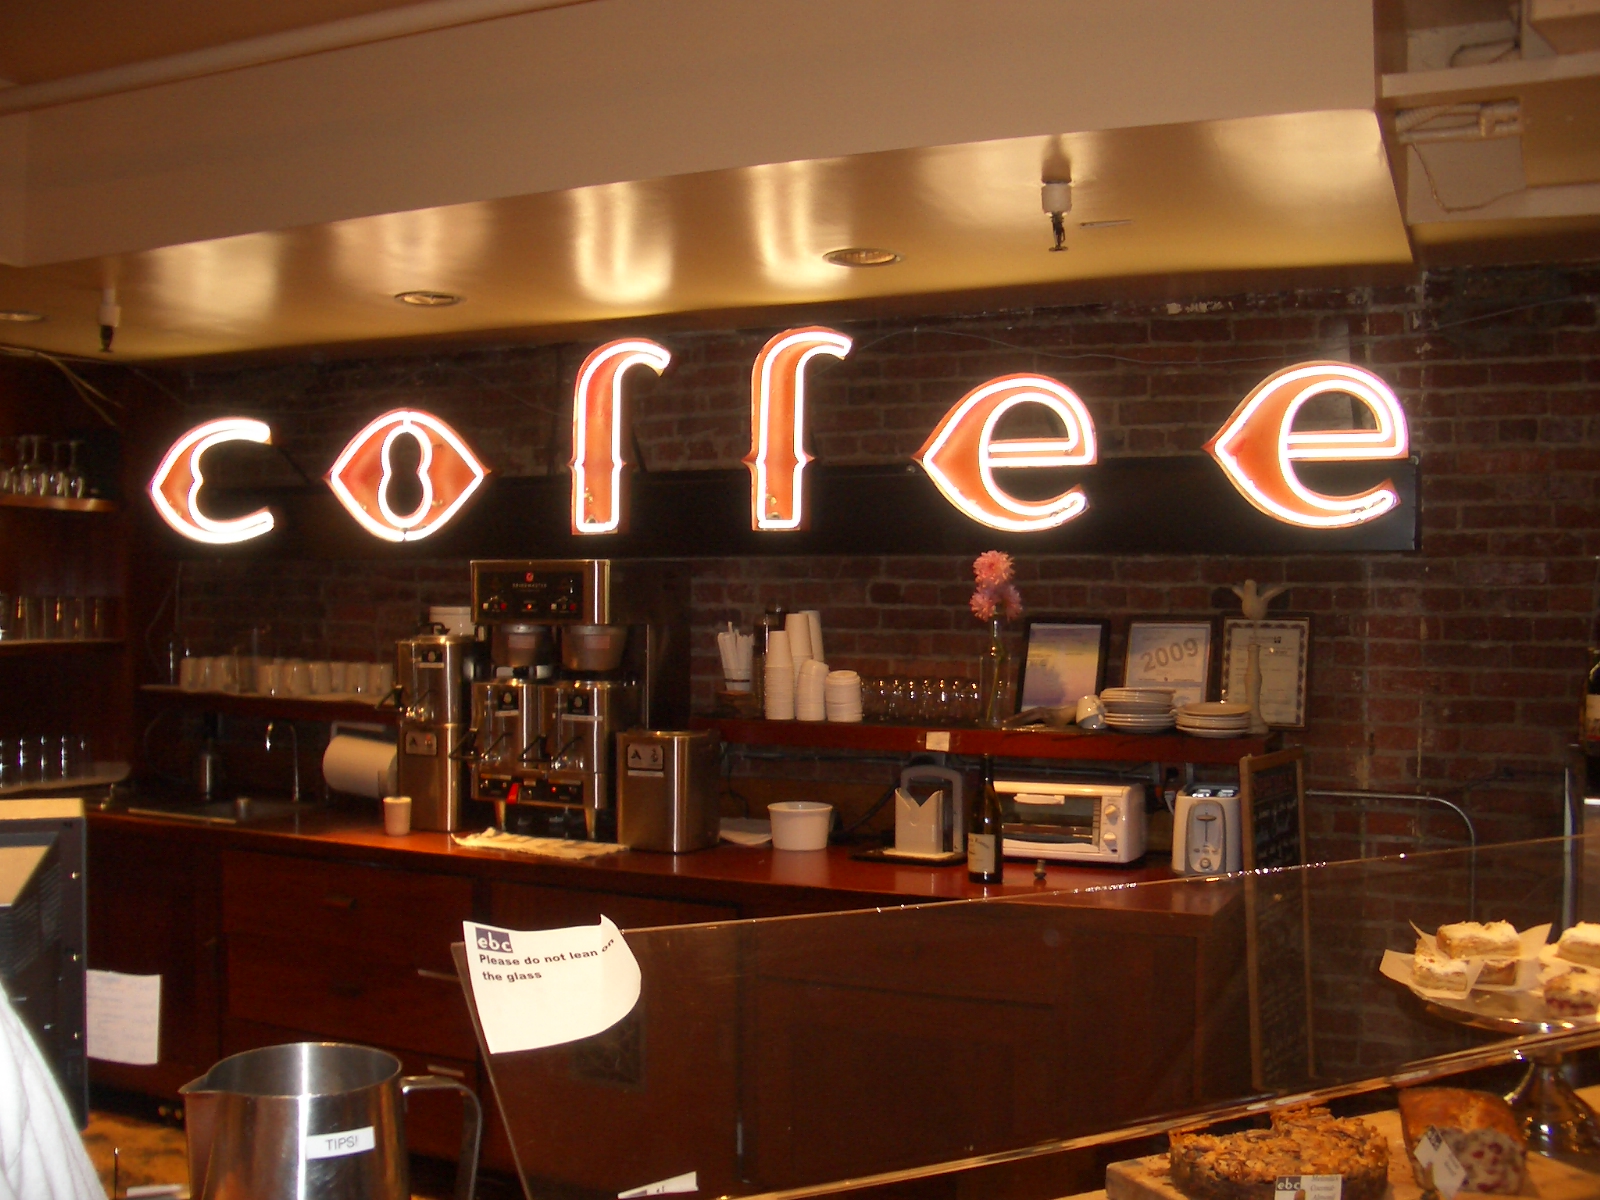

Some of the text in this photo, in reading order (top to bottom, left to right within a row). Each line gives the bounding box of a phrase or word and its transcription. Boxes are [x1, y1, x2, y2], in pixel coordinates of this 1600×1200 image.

[147, 326, 1410, 544] coffee
[1140, 638, 1199, 672] 2009
[477, 931, 512, 952] ebc
[479, 939, 614, 966] Please do not lean on
[482, 971, 542, 983] the glass
[1277, 1177, 1301, 1190] ebc
